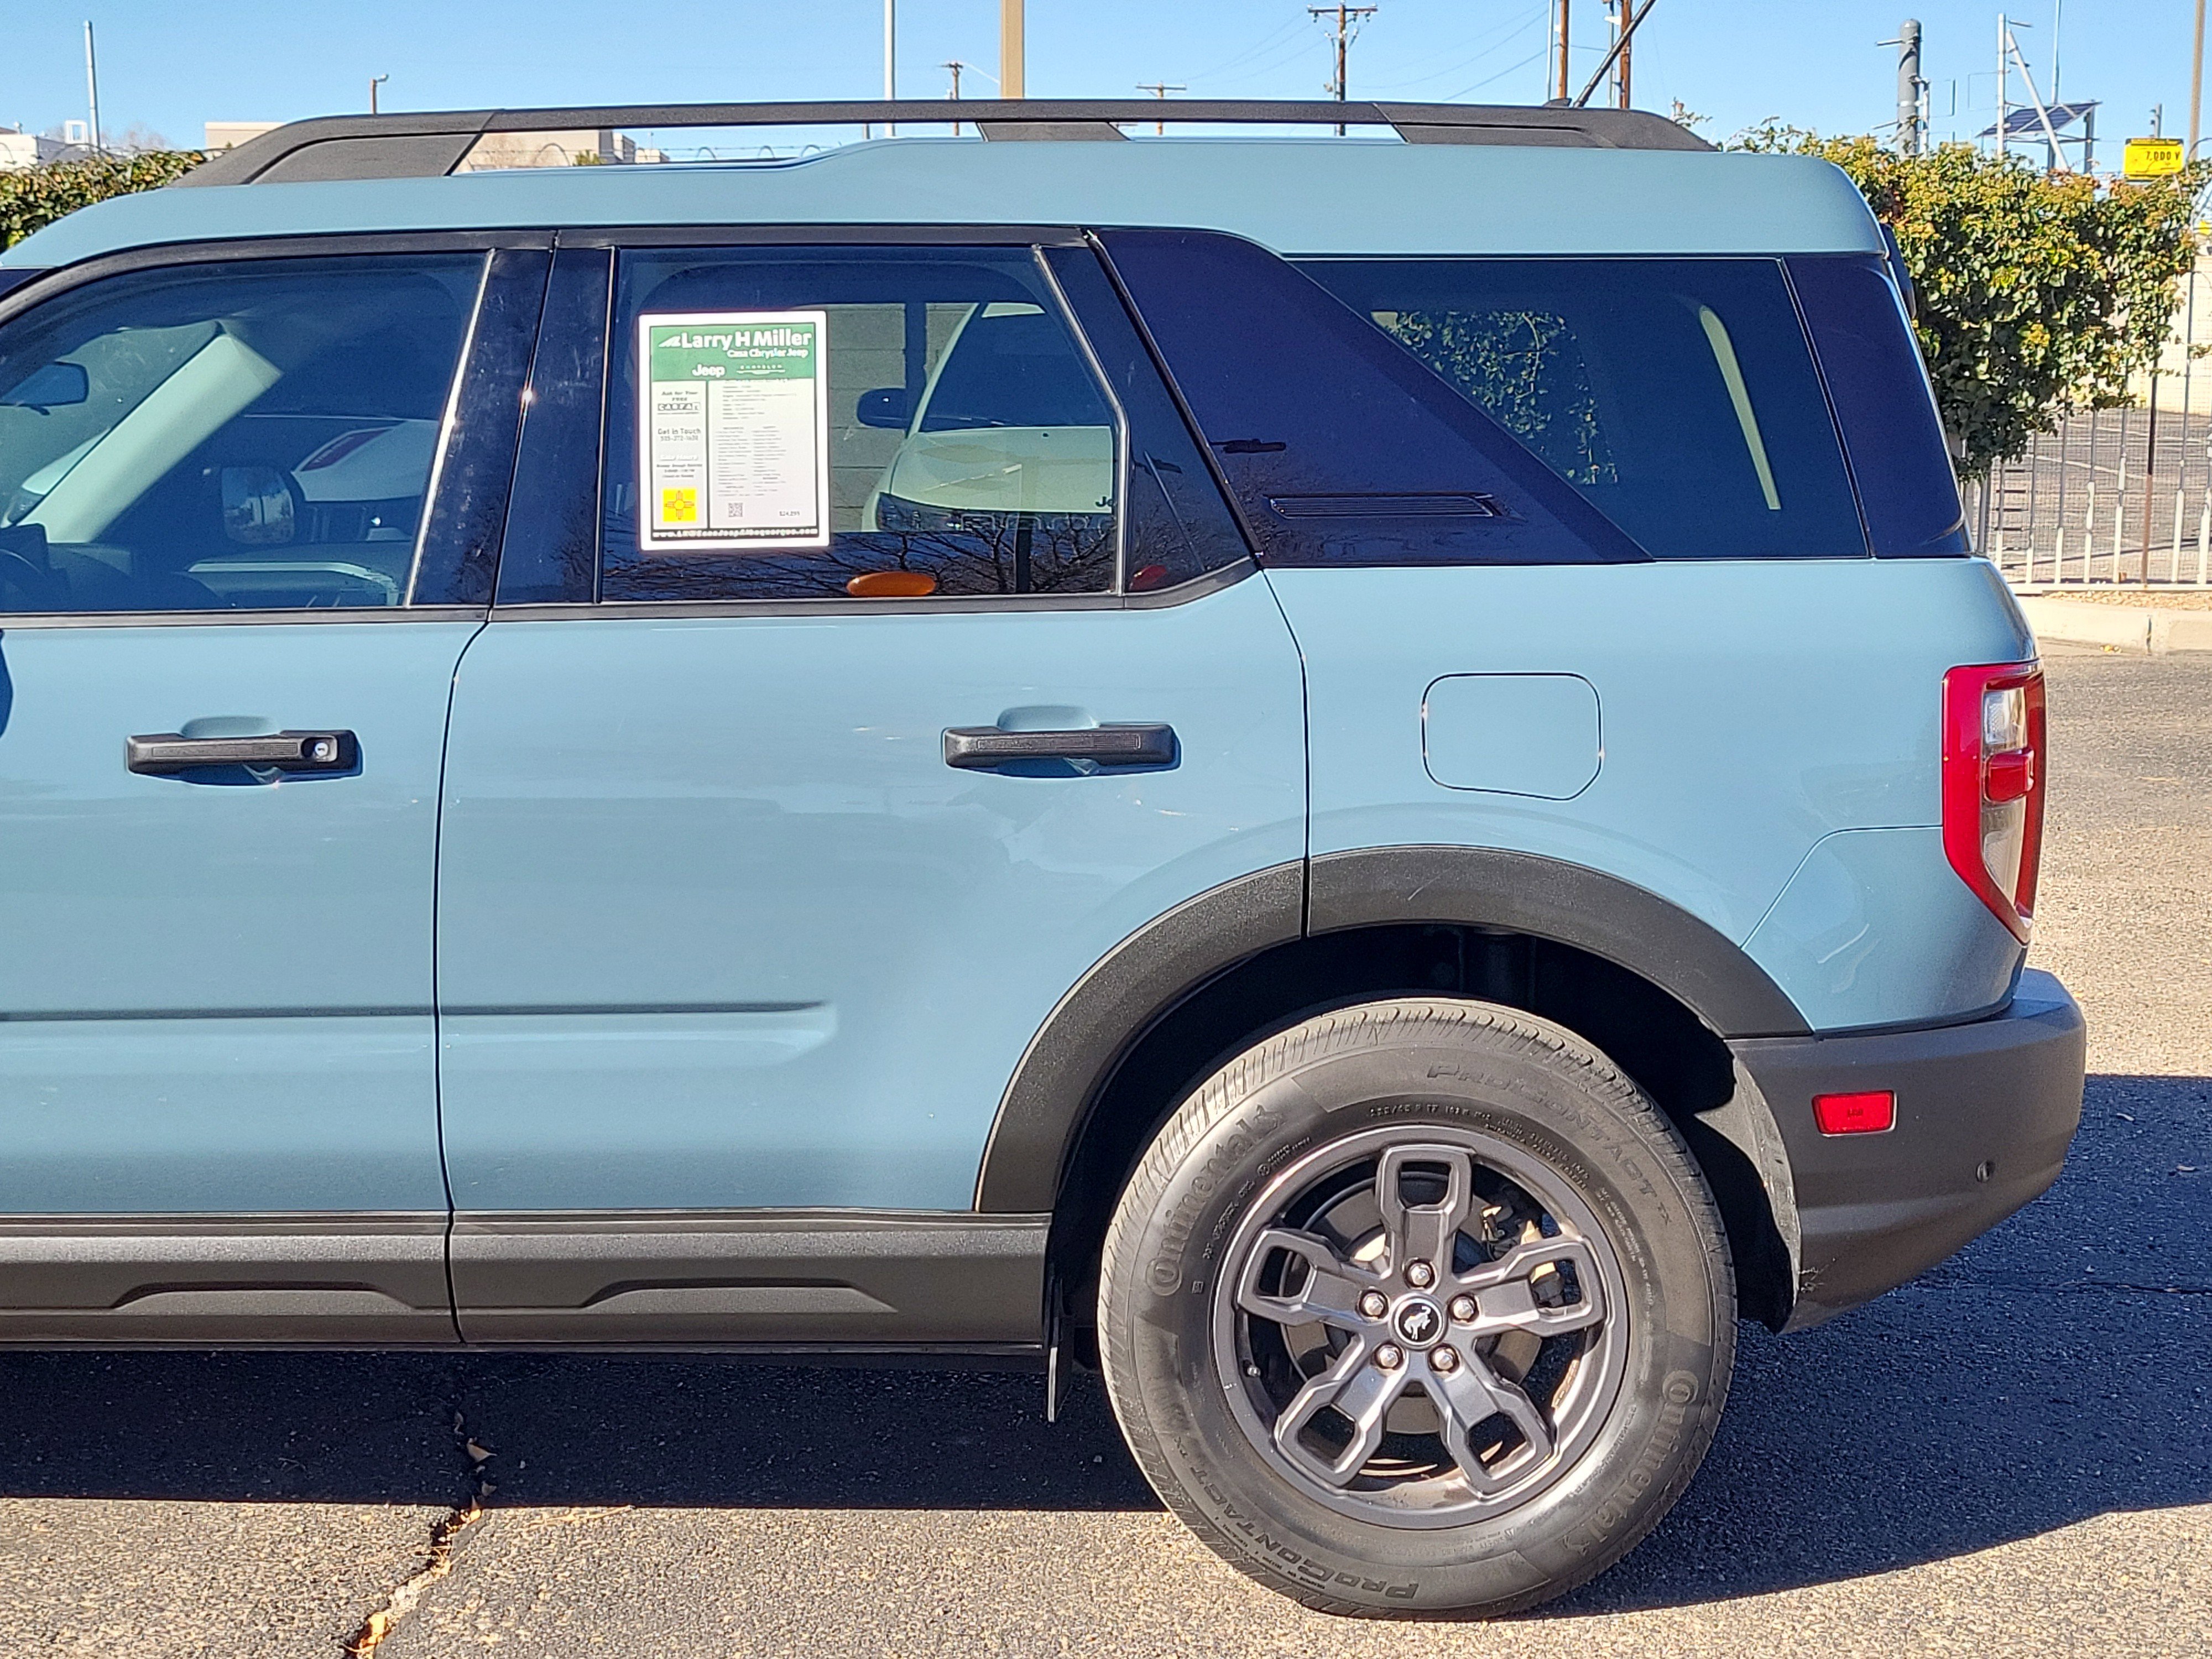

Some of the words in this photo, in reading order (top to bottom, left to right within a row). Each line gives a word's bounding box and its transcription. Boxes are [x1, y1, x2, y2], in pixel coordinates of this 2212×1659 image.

[681, 332, 733, 351] Larry
[735, 331, 750, 347] H
[753, 328, 812, 347] Miller
[749, 348, 786, 359] Chrysler
[692, 363, 726, 378] Jeep
[1587, 1369, 1699, 1544] Continental
